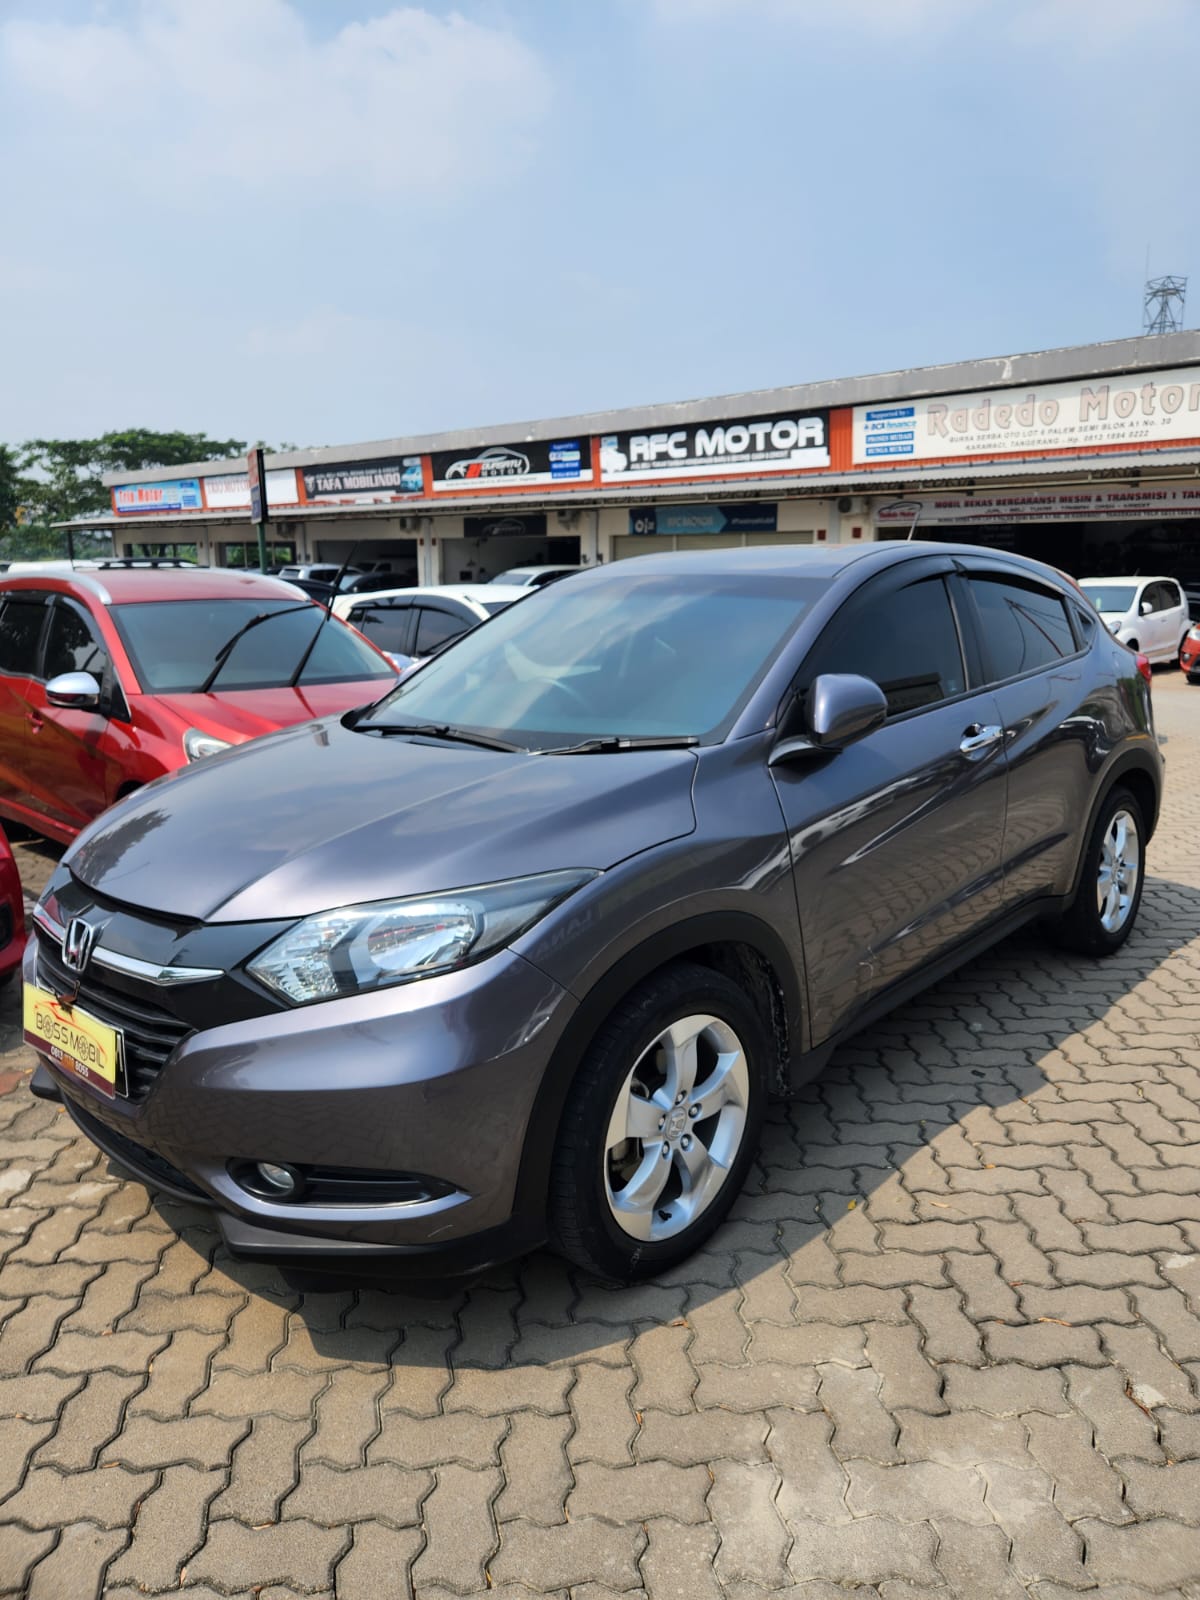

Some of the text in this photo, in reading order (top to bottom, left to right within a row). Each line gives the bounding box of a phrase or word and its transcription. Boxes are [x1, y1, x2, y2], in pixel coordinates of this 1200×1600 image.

[927, 381, 1200, 438] Radedo Motor
[695, 416, 825, 457] MOTOR
[1048, 426, 1076, 435] PALEM
[1101, 421, 1126, 431] BLOK
[316, 478, 342, 491] TAFA
[343, 472, 400, 489] MOBILINDO
[964, 499, 993, 508] BEKAS
[1059, 495, 1092, 504] MESIN
[1107, 491, 1167, 501] TRANSMISI
